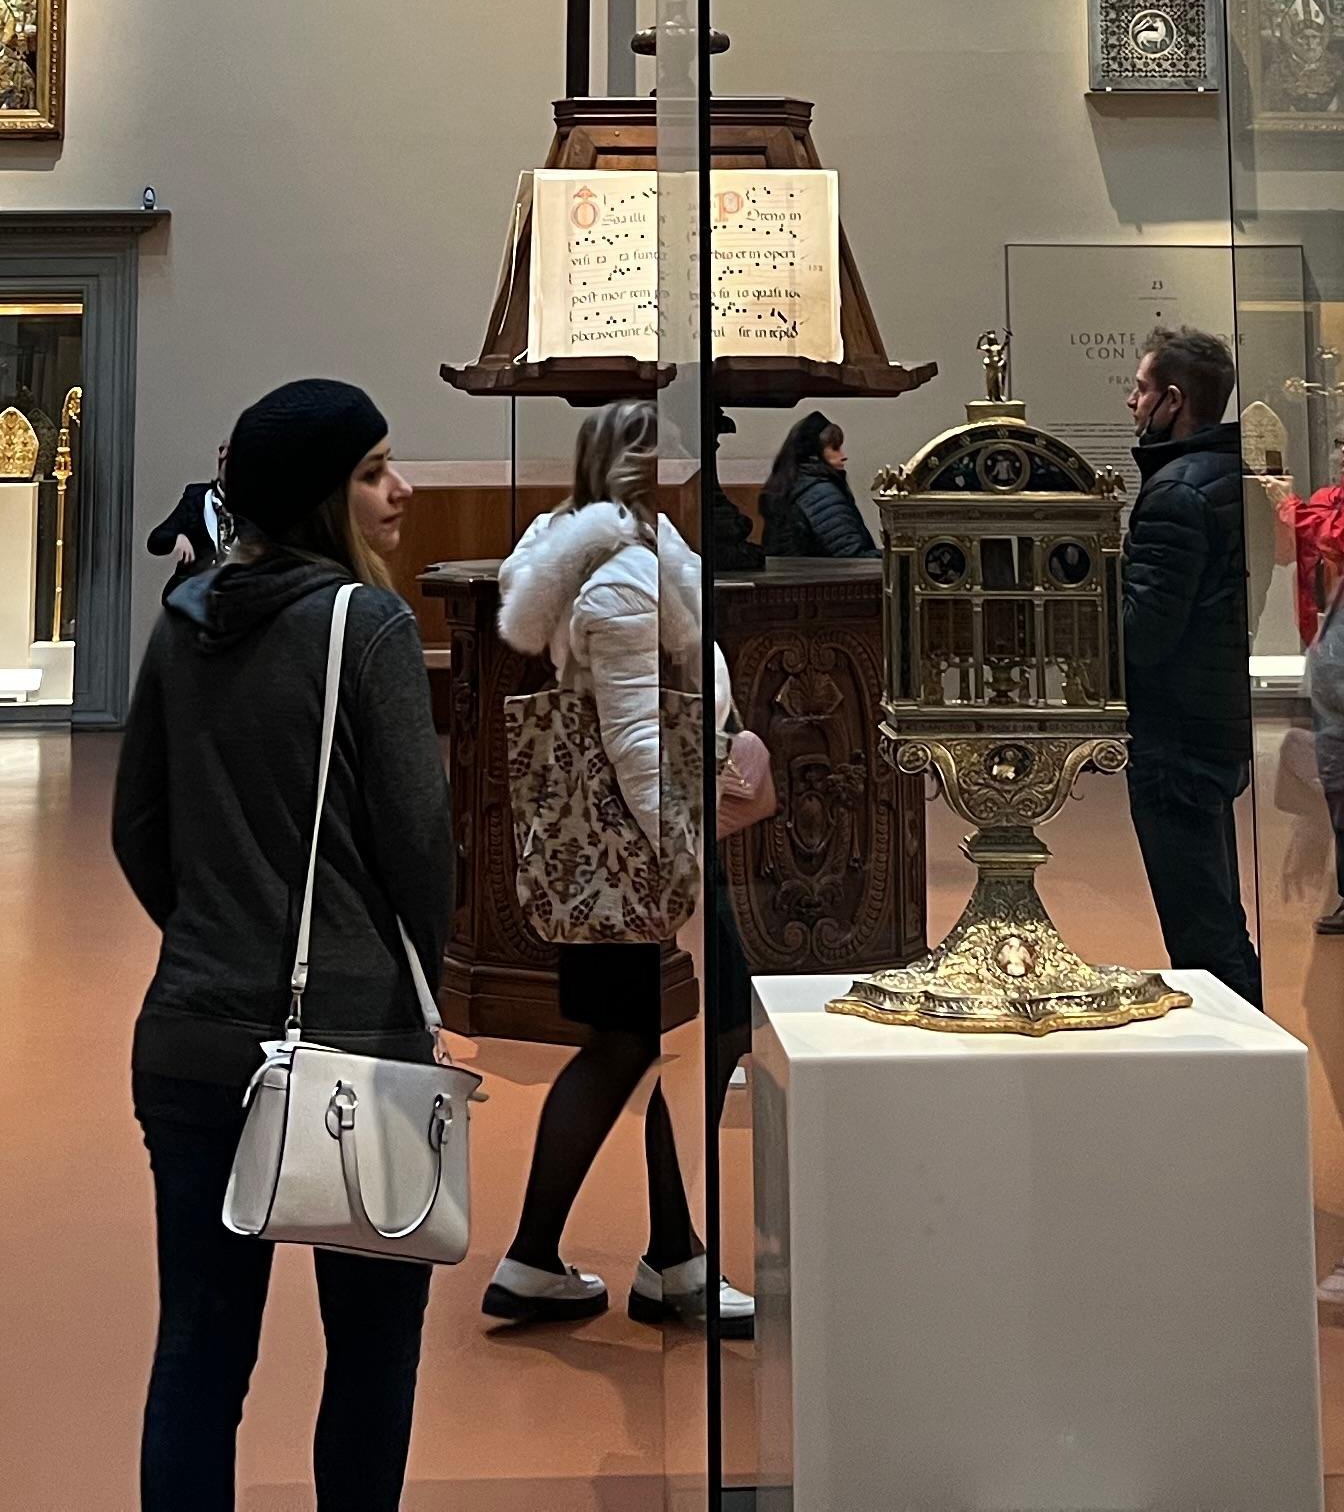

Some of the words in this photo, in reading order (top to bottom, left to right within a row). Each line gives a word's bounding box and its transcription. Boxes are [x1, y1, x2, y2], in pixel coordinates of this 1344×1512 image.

[1151, 281, 1164, 290] 23
[1070, 332, 1135, 345] LODATE
[1085, 347, 1125, 360] CON
